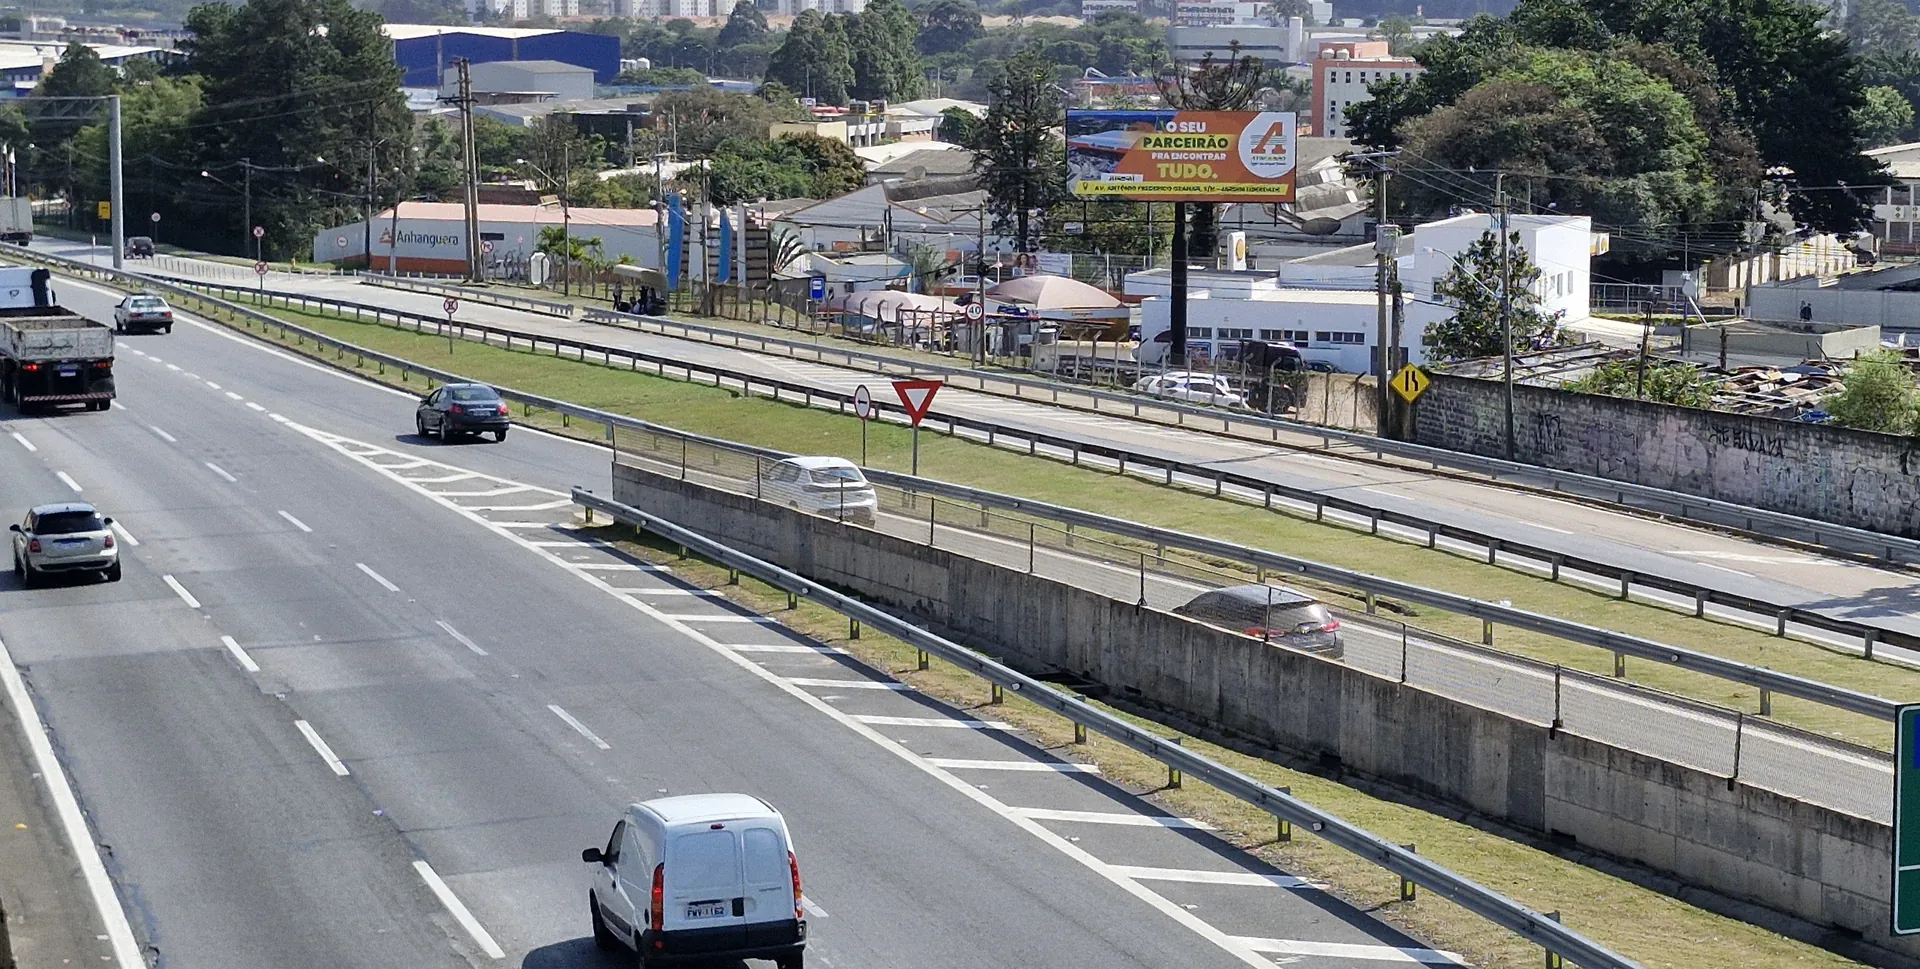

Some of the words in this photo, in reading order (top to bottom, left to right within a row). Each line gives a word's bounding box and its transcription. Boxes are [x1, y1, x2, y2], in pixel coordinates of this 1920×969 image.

[1166, 121, 1177, 133] O
[1180, 121, 1206, 133] SEU
[1143, 134, 1228, 149] PARCEIRÃO
[1152, 152, 1169, 160] PRA
[1171, 152, 1227, 160] ENCONTRAR
[1157, 163, 1218, 179] TUDO.
[397, 230, 459, 248] Anhanguera
[969, 306, 981, 315] 40
